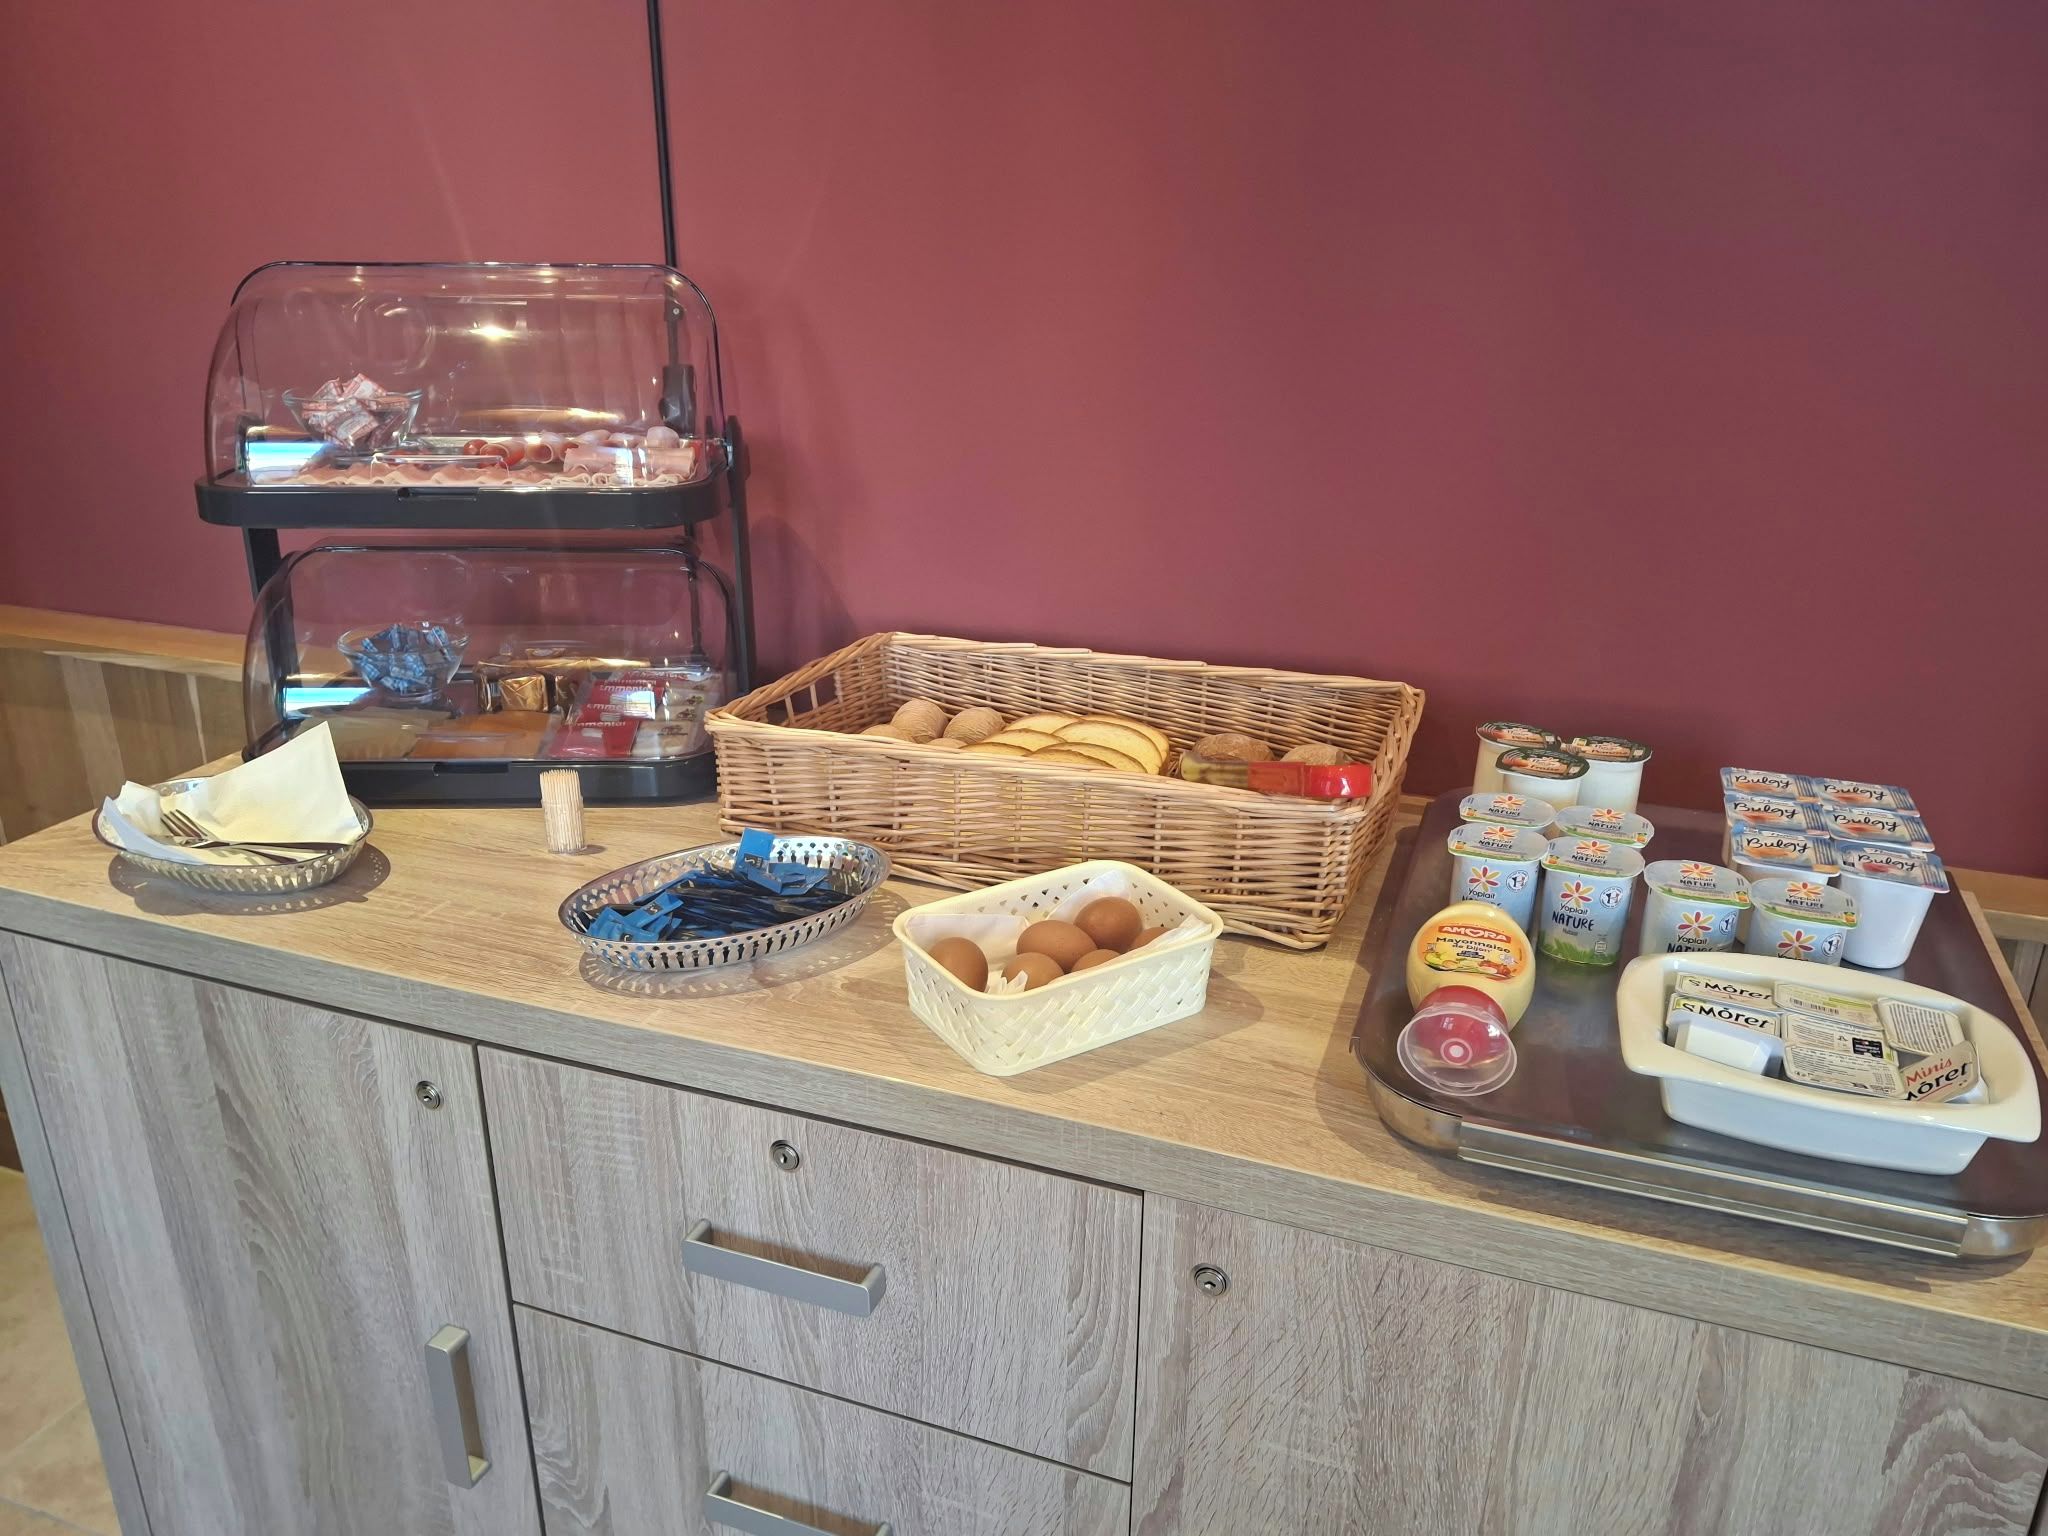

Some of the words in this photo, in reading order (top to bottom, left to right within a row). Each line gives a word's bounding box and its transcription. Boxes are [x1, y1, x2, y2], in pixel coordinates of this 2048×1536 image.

[1735, 775, 1792, 789] Bulgy
[1824, 784, 1887, 800] Bulgy
[1734, 802, 1799, 819] Bulgy
[1833, 814, 1900, 833] Bulgy
[1746, 838, 1811, 854] Bulgy
[1858, 855, 1917, 871] Bulgy
[1468, 887, 1496, 899] Yoplait
[1560, 902, 1588, 914] Yoplait
[1552, 910, 1595, 931] NATURE
[1442, 926, 1508, 942] AMORA
[1677, 934, 1708, 945] Yoplait
[1436, 936, 1511, 954] Mayonnaise
[1698, 1005, 1771, 1029] Môret
[1906, 1058, 1953, 1087] Minis
